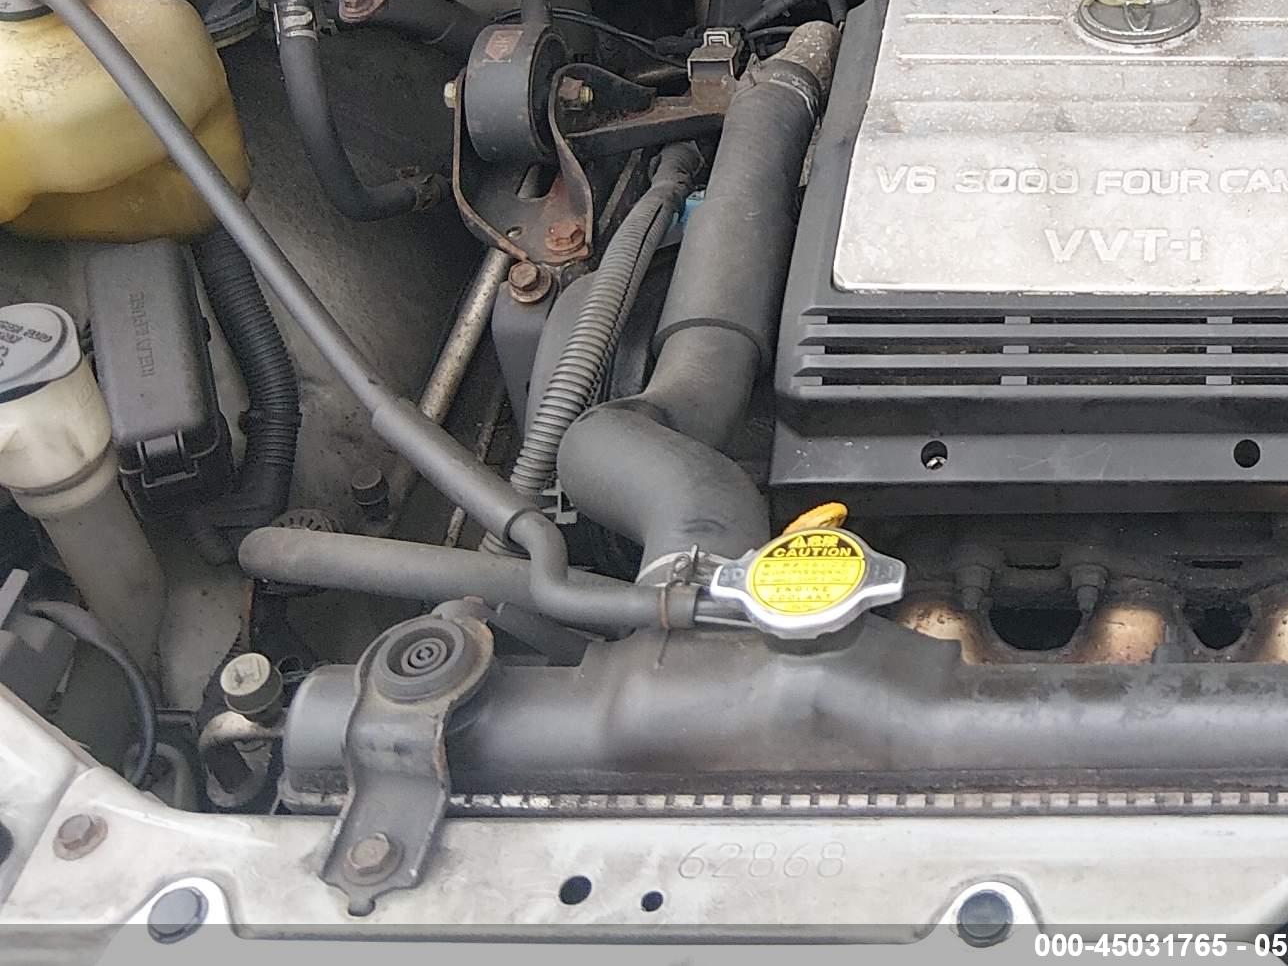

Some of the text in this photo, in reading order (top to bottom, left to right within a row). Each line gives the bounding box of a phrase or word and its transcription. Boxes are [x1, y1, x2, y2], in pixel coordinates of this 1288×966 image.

[875, 165, 936, 194] V6
[953, 167, 1079, 194] 3000
[1094, 168, 1211, 195] FOUR
[1043, 227, 1207, 263] VVT-i
[772, 547, 852, 558] CAUTION
[678, 841, 846, 880] 62868
